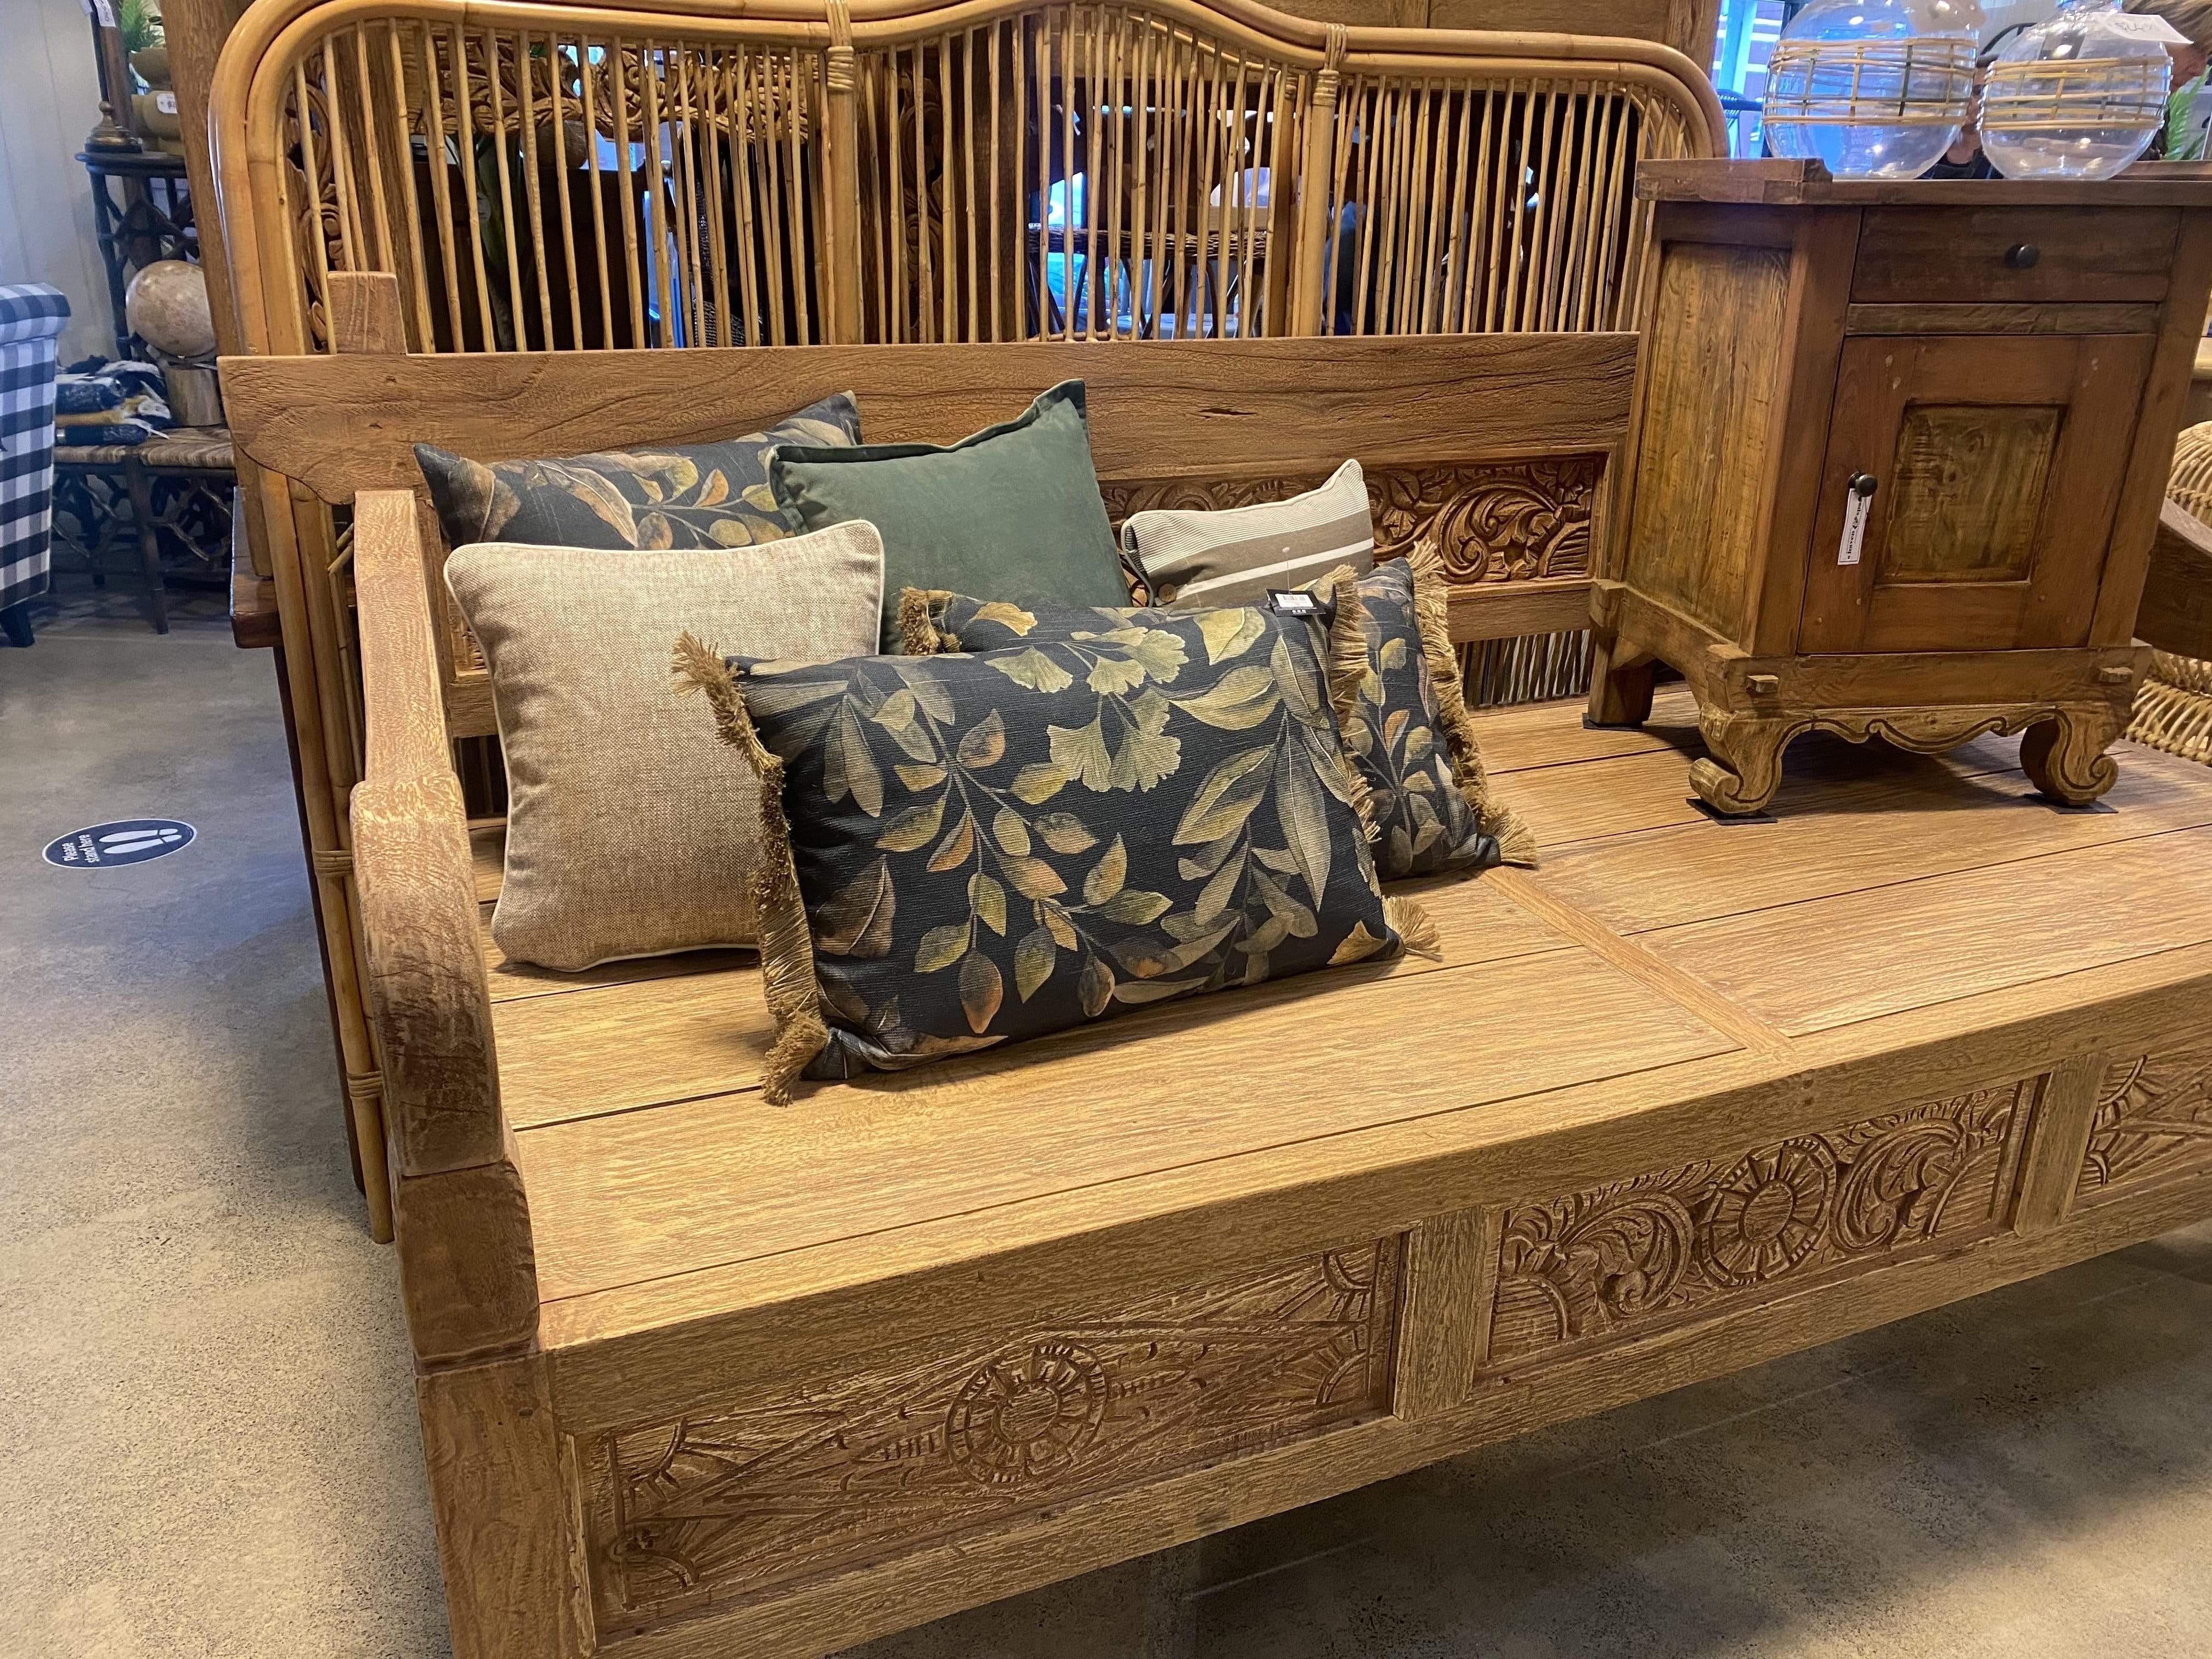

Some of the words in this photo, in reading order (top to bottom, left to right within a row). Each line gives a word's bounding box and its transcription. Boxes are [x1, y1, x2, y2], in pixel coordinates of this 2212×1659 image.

[78, 834, 93, 848] here
[62, 843, 78, 861] Please
[78, 847, 99, 862] stand
